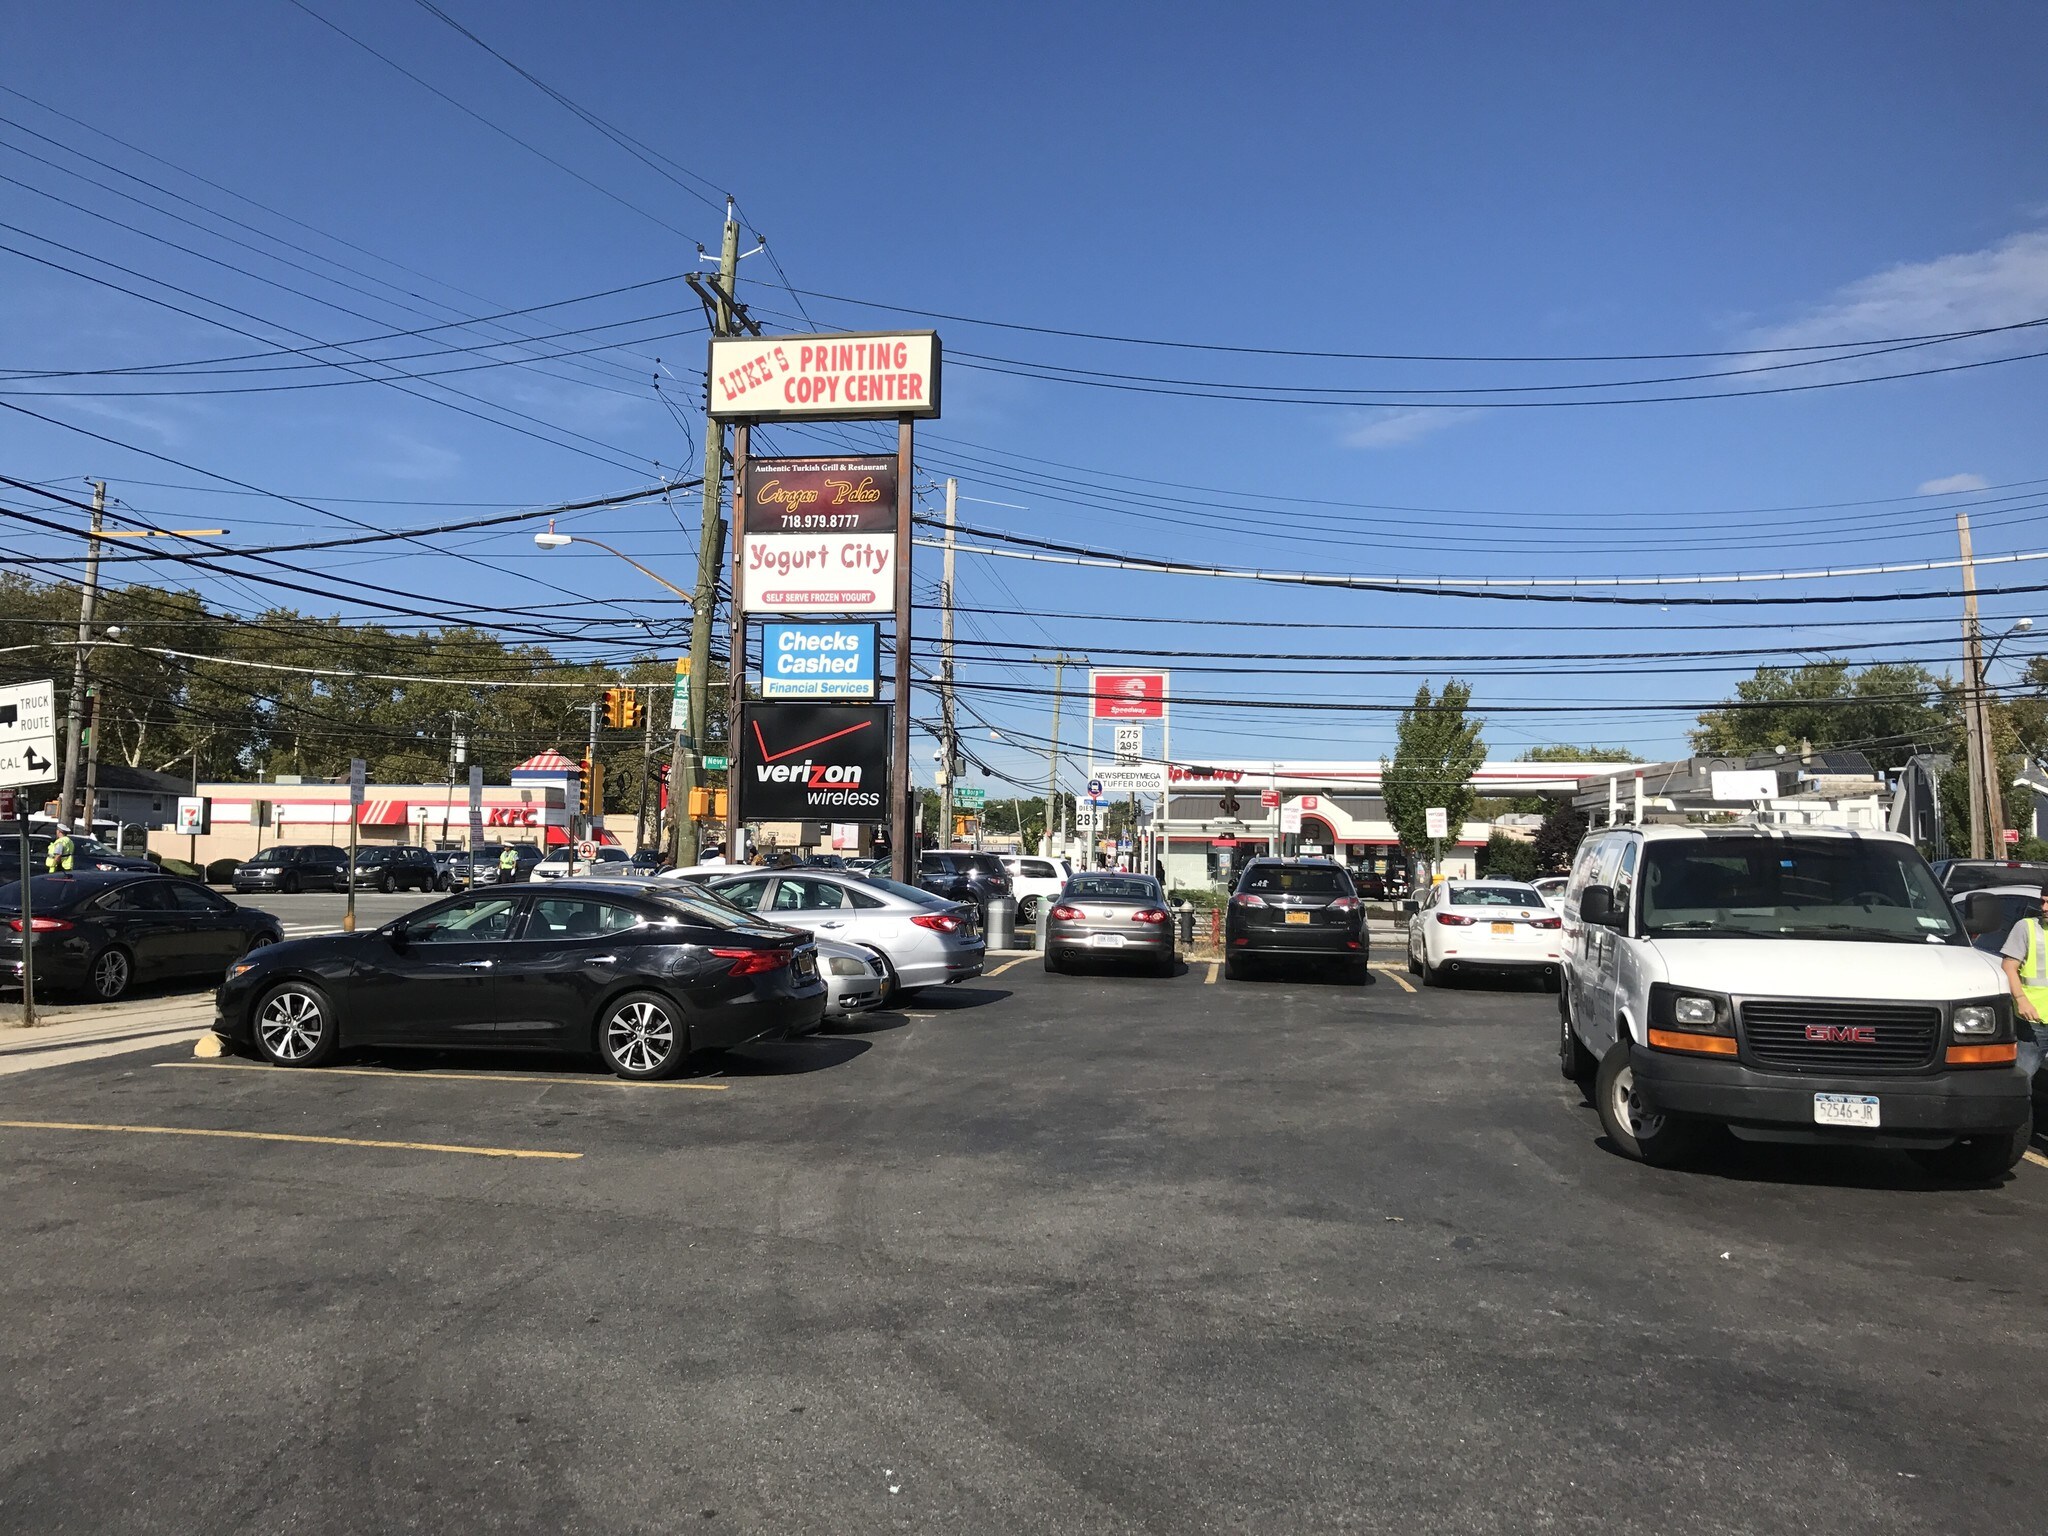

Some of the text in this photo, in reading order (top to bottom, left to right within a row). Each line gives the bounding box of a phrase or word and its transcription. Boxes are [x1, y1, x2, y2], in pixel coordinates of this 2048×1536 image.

[719, 342, 907, 401] LUKE'S PRINTING
[784, 373, 923, 403] COPY CENTER
[755, 465, 791, 473] Authentic
[792, 464, 820, 472] Turkish
[821, 464, 838, 472] Grill
[824, 476, 880, 504] Palace
[781, 514, 859, 528] 718.979.8777
[749, 543, 889, 576] Yogurt City
[766, 592, 871, 602] SELF SERVE FROZEN YOGURT
[778, 631, 859, 651] Checks
[777, 654, 859, 674] Cashed
[769, 682, 869, 693] Financial Services
[20, 695, 49, 710] TRUCK
[1110, 706, 1146, 714] Speedway
[21, 716, 49, 731] ROUTE
[1120, 730, 1138, 739] 275
[1120, 741, 1138, 750] 295
[0, 757, 21, 770] CAL
[708, 757, 723, 765] New
[756, 760, 862, 788] verizon
[1095, 772, 1161, 780] NEWSPEEDYMEGA
[1103, 780, 1160, 788] TUFFER BOGO
[807, 789, 880, 806] wireless
[488, 808, 538, 828] KFC
[1805, 1025, 1875, 1042] GMC
